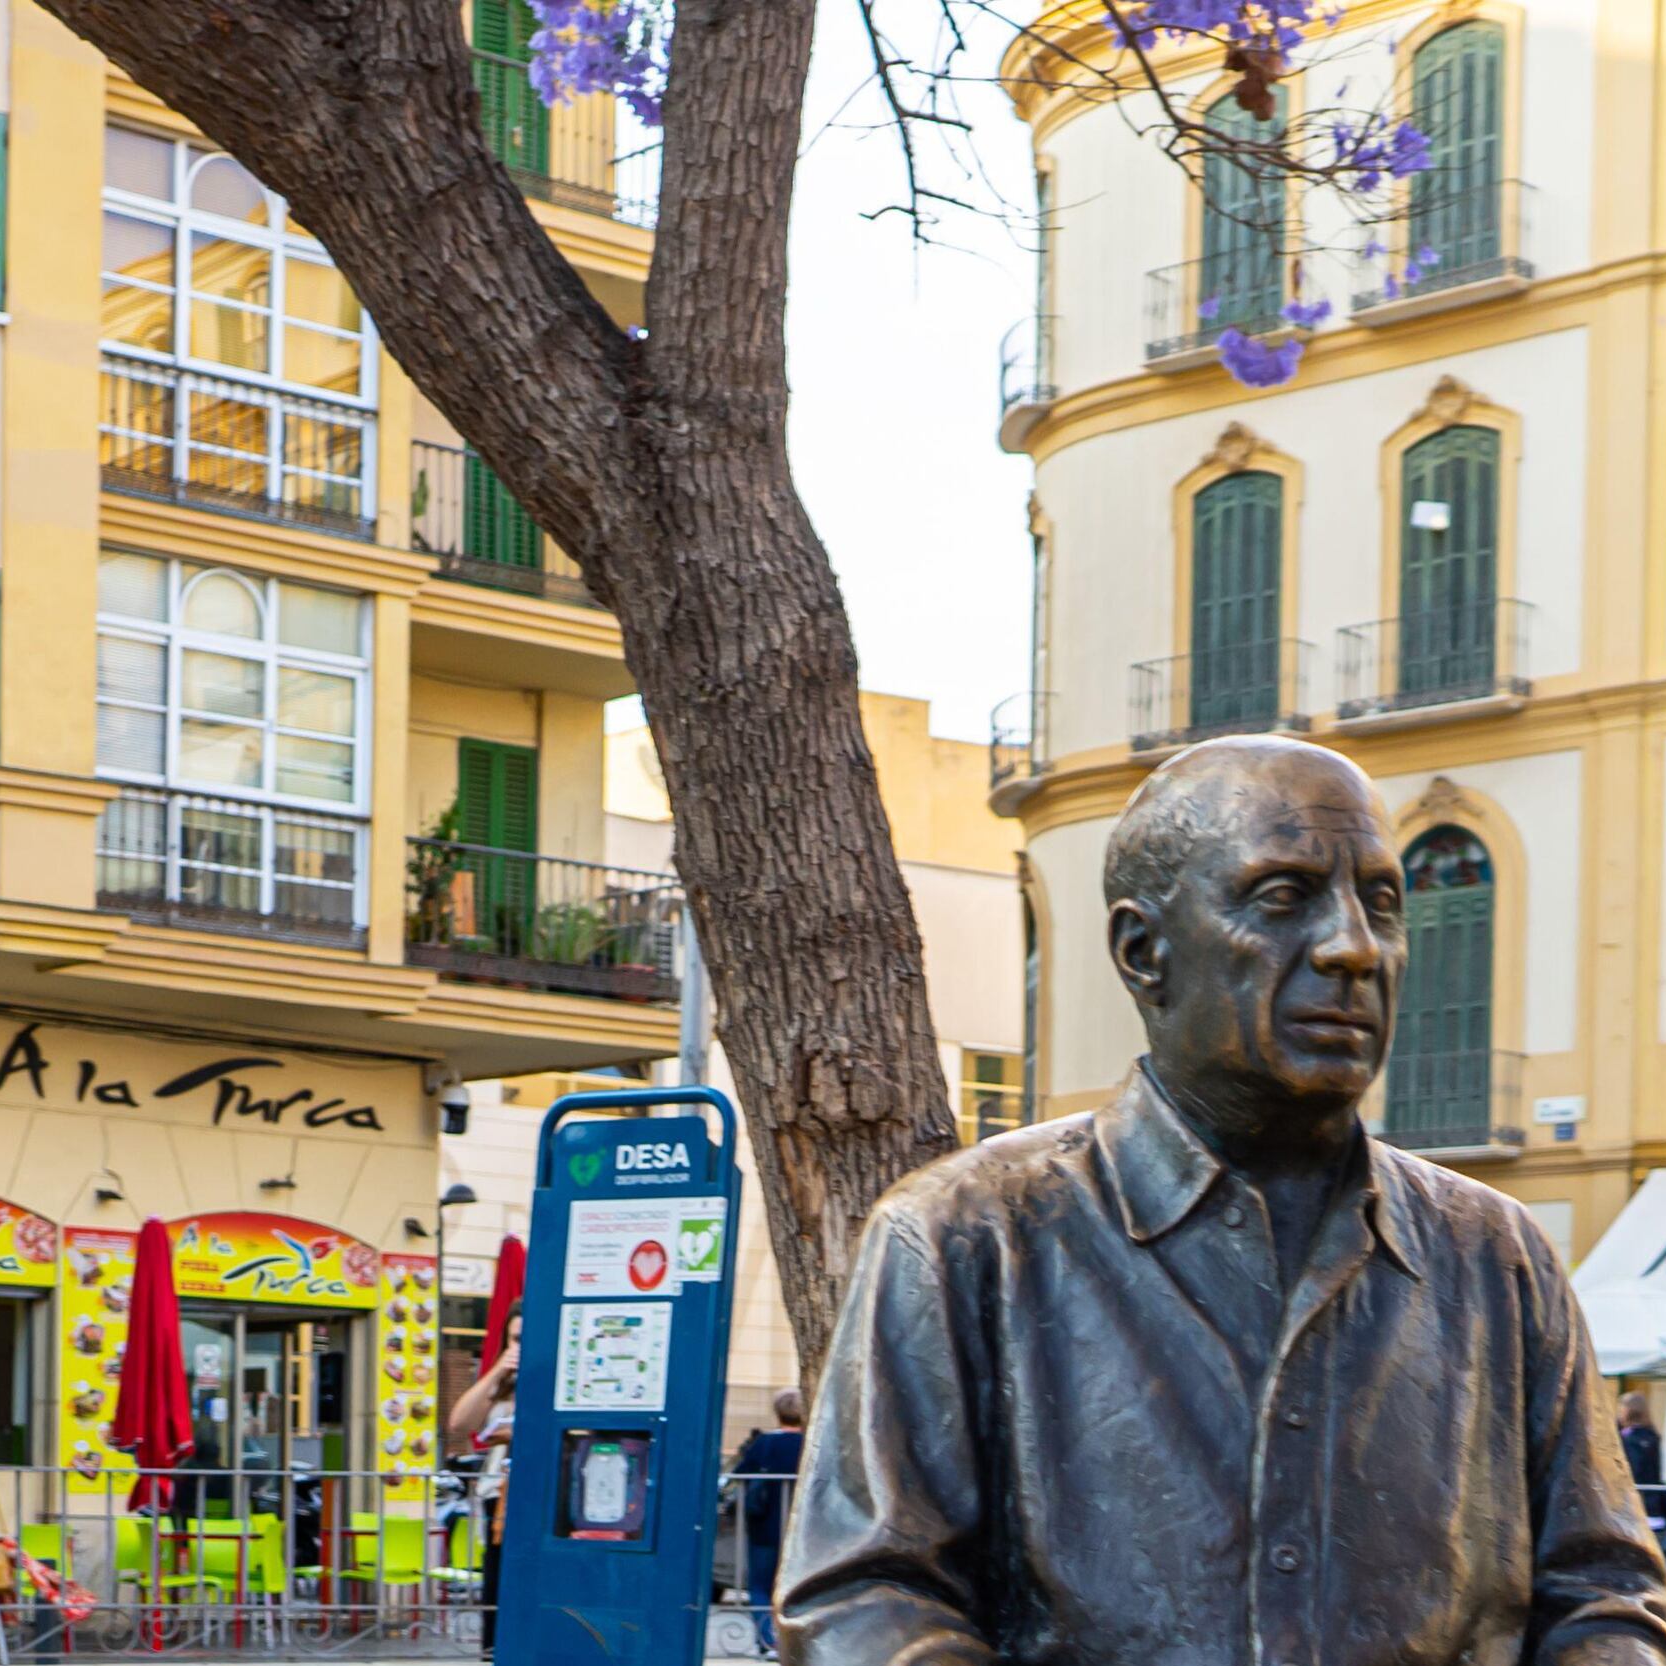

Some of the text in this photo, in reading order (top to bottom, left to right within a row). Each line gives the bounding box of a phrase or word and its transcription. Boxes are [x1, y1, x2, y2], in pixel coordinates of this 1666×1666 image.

[77, 1060, 139, 1107] la
[153, 1057, 384, 1131] Turca
[615, 1142, 691, 1170] DESA
[221, 1254, 350, 1298] Turca
